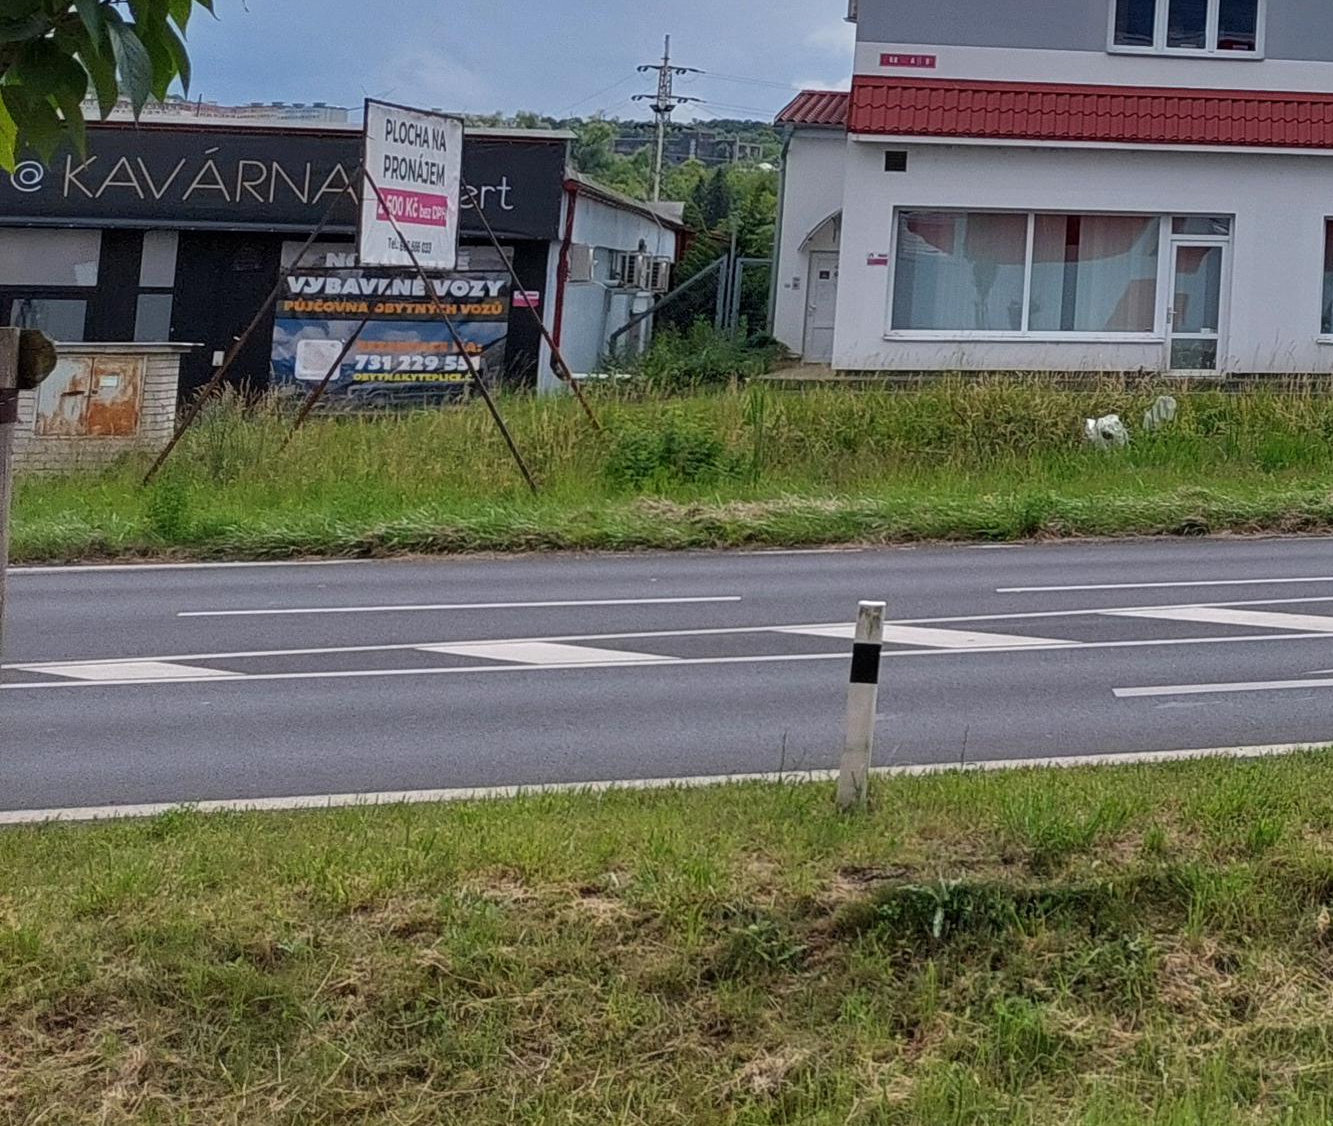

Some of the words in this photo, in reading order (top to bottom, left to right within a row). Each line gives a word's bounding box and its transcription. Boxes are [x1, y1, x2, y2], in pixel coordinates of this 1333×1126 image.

[385, 118, 430, 149] PLOCHA
[431, 126, 447, 152] NA
[63, 147, 359, 205] KAVÁRNA
[460, 176, 514, 210] ert
[383, 154, 445, 187] PRONÁJEM
[405, 196, 418, 218] Kč
[433, 280, 507, 298] VOZY
[354, 354, 391, 371] 731
[399, 354, 439, 371] 229
